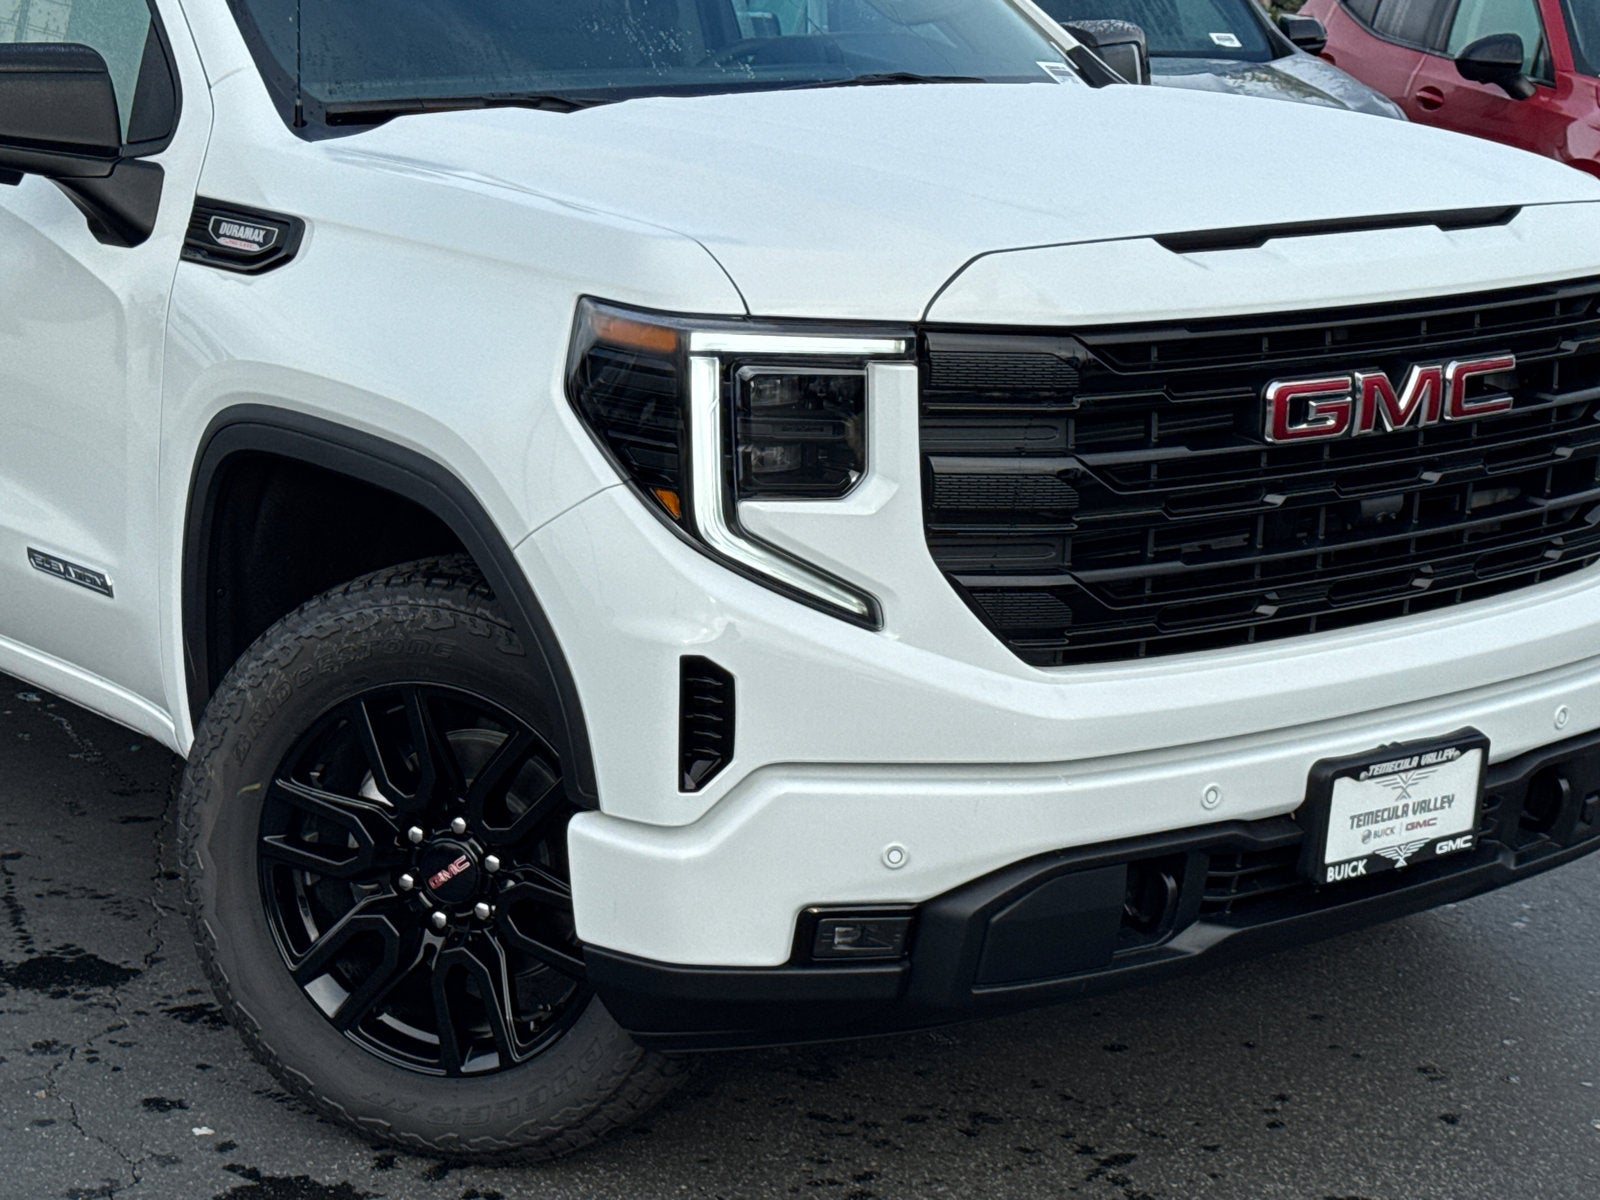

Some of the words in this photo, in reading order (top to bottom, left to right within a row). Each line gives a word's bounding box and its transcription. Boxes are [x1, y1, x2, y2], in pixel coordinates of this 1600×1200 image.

[219, 222, 266, 243] DURAMAX
[1264, 353, 1516, 445] GMC
[1368, 756, 1418, 777] TEMECULA
[1420, 747, 1455, 766] VALLEY
[1349, 802, 1409, 830] TEMECULA
[1412, 793, 1455, 816] VALLEY
[1372, 826, 1396, 839] BUICK
[1405, 817, 1438, 832] GMC
[428, 854, 471, 890] GMC
[1326, 859, 1368, 883] BUICK
[1435, 835, 1473, 855] GMC
